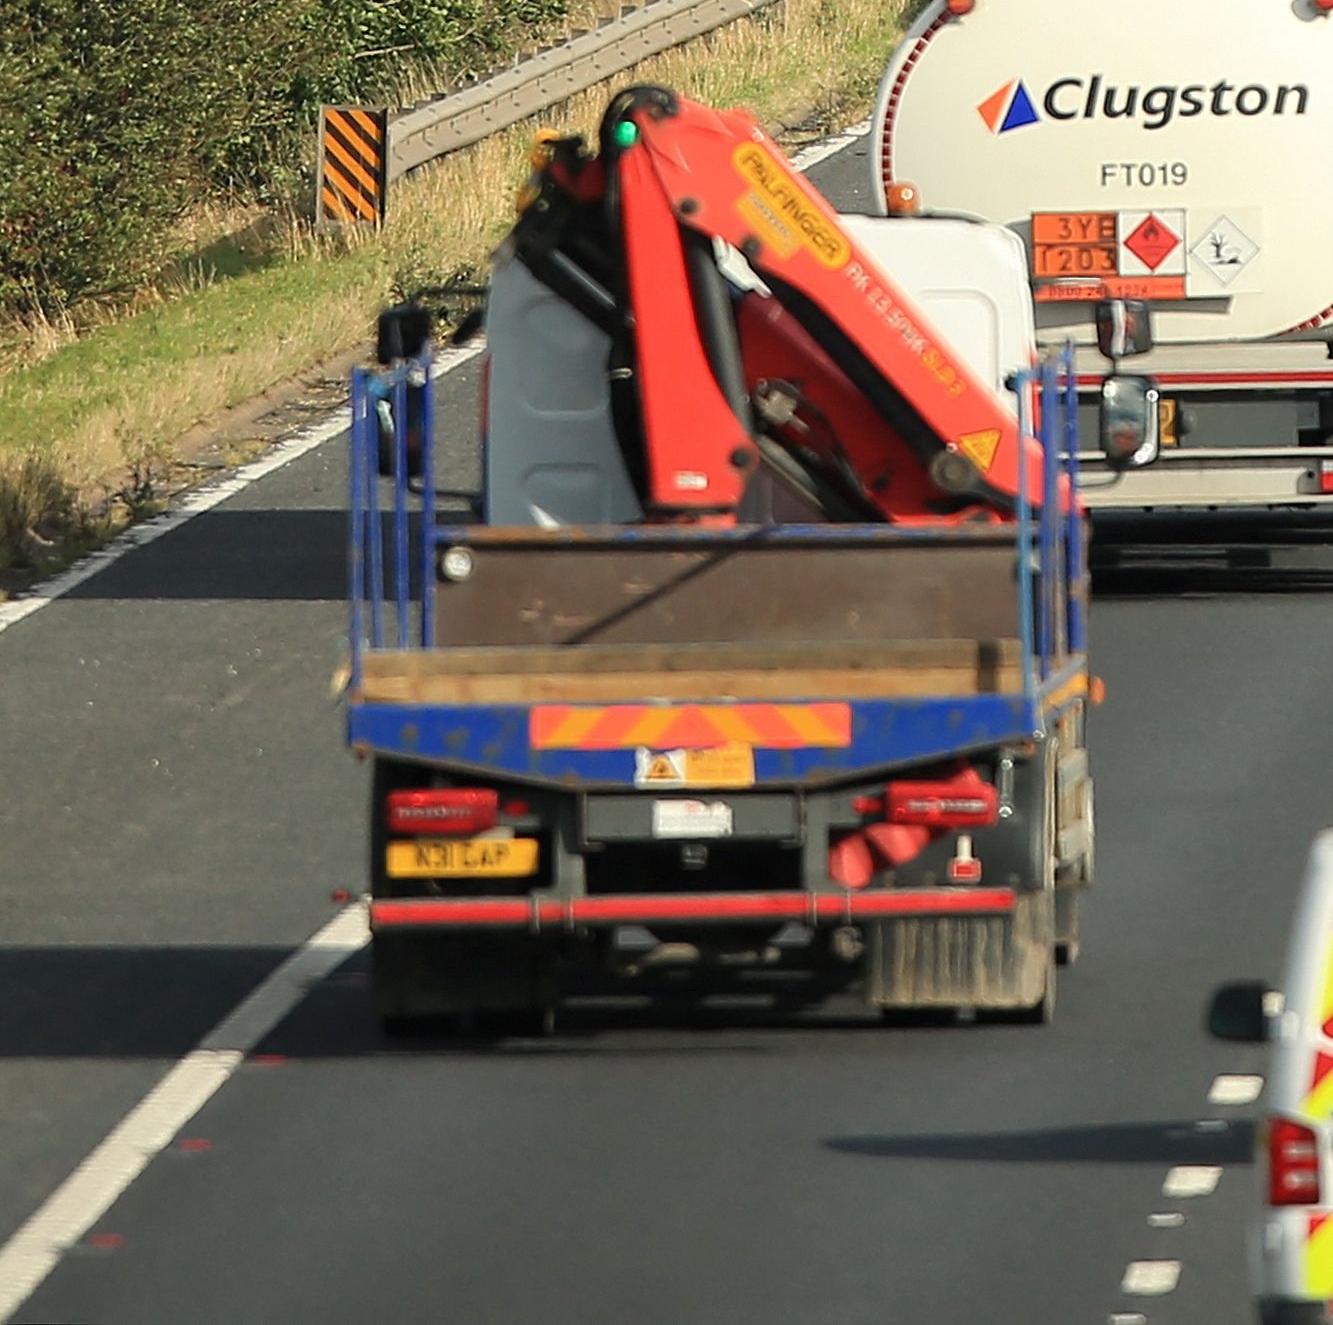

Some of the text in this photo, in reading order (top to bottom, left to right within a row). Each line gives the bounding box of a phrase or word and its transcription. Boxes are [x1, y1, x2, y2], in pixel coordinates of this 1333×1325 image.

[1042, 72, 1311, 131] Clugston
[1100, 161, 1189, 187] FT019
[1041, 248, 1115, 272] 1203
